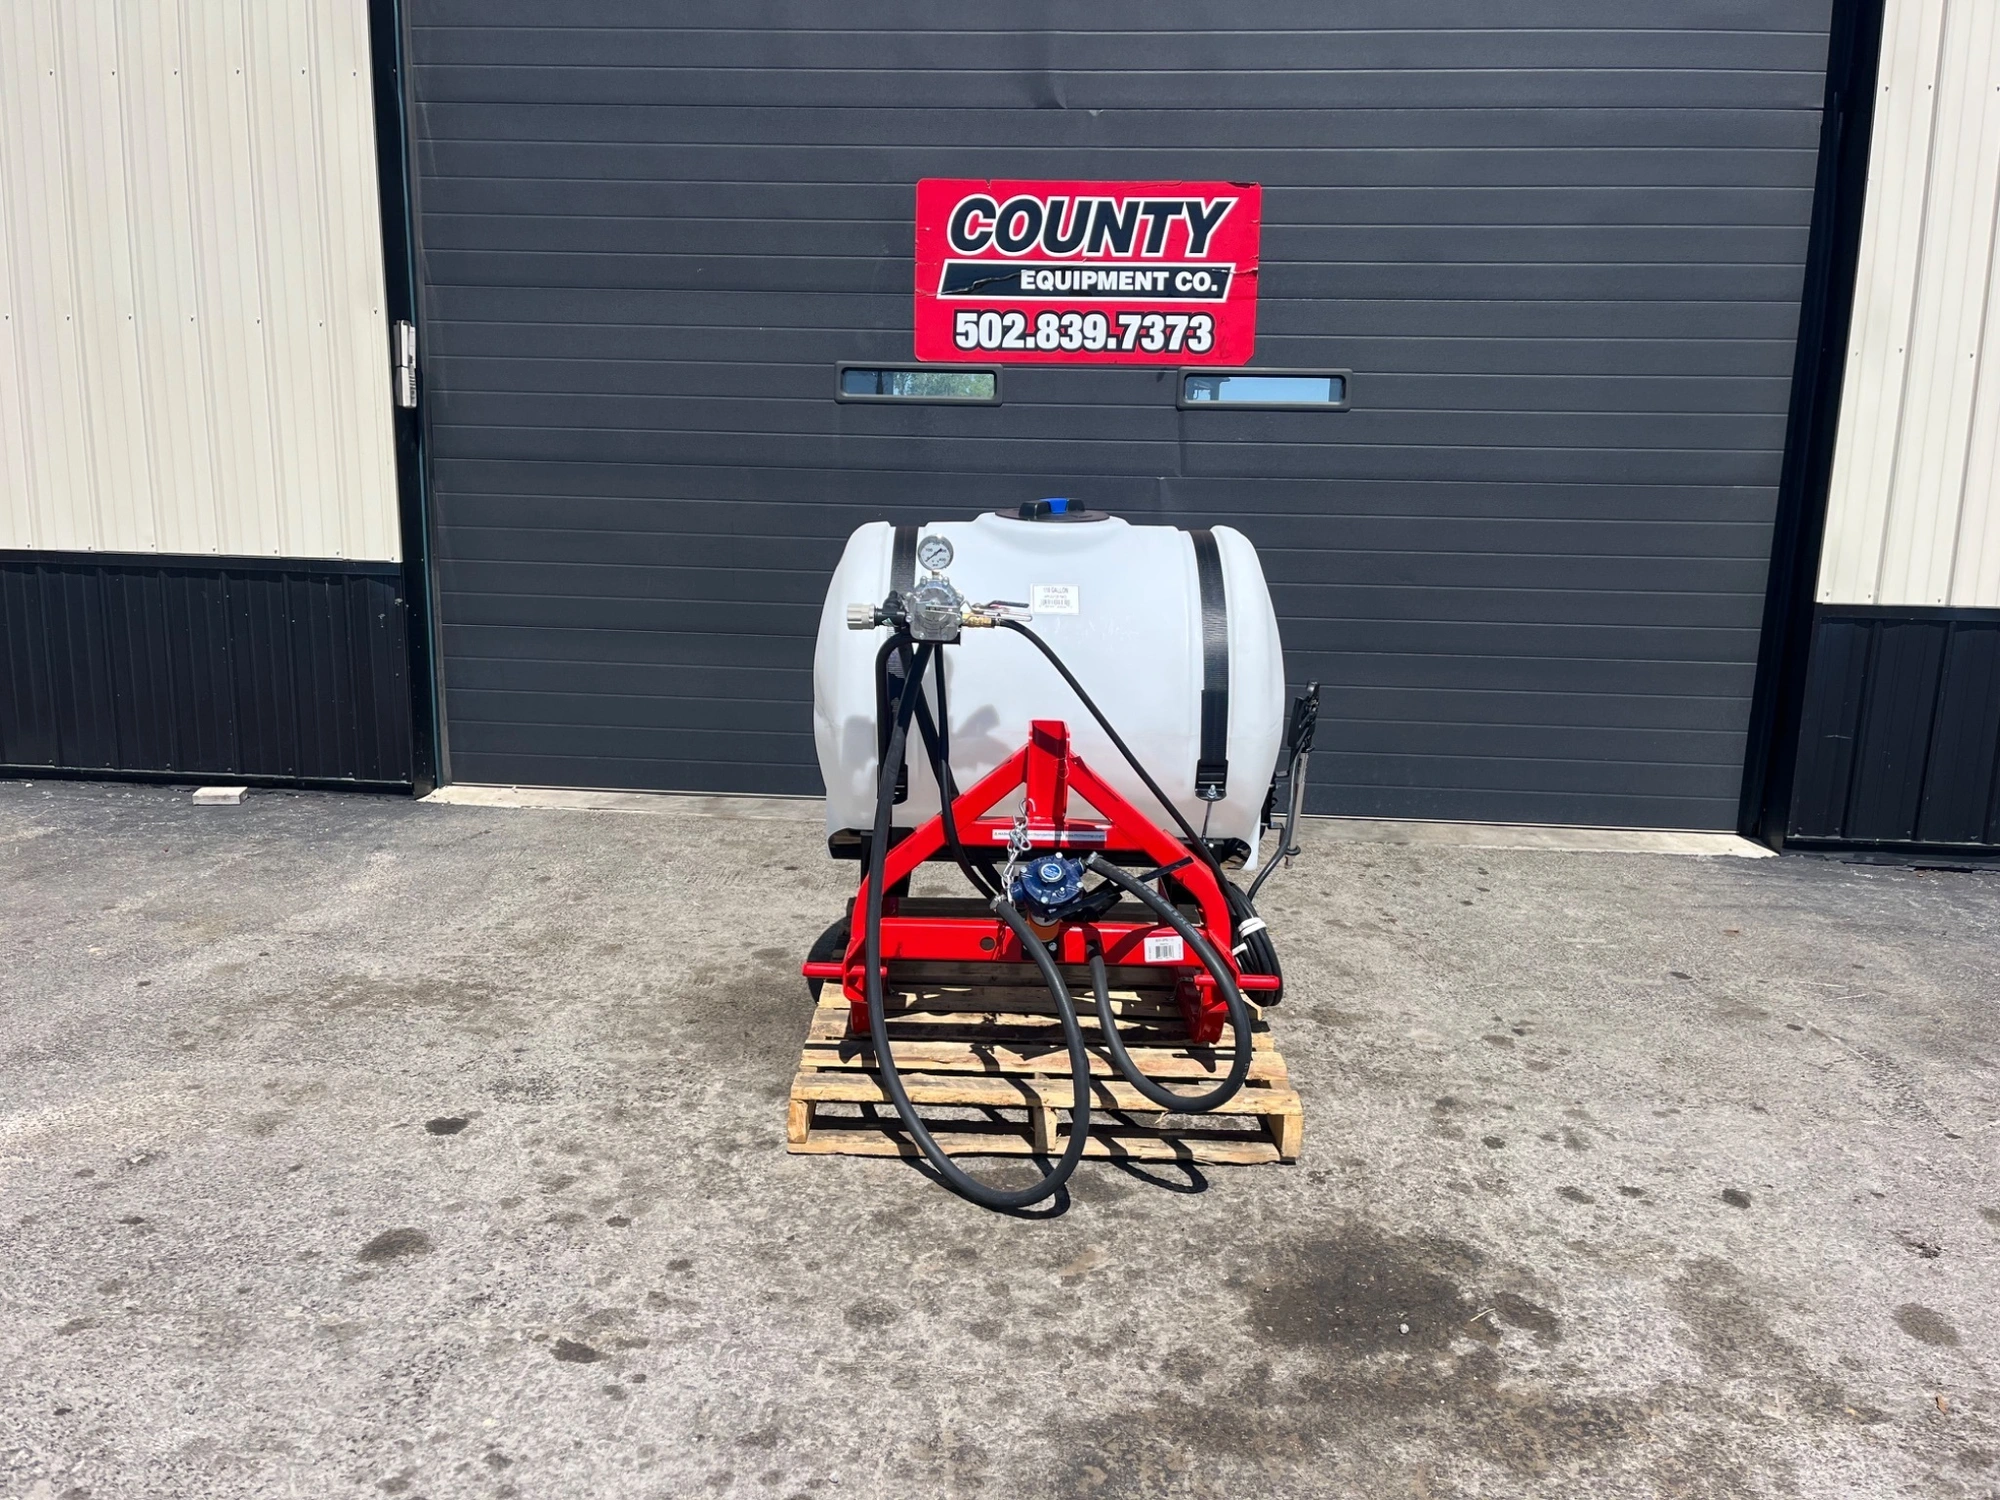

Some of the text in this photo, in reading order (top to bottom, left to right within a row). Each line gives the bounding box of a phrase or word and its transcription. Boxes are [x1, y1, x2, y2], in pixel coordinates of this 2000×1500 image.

[946, 194, 1239, 258] COUNTY
[1020, 270, 1218, 291] EQUIPMENT CO.
[954, 310, 1215, 353] 502.839.7373
